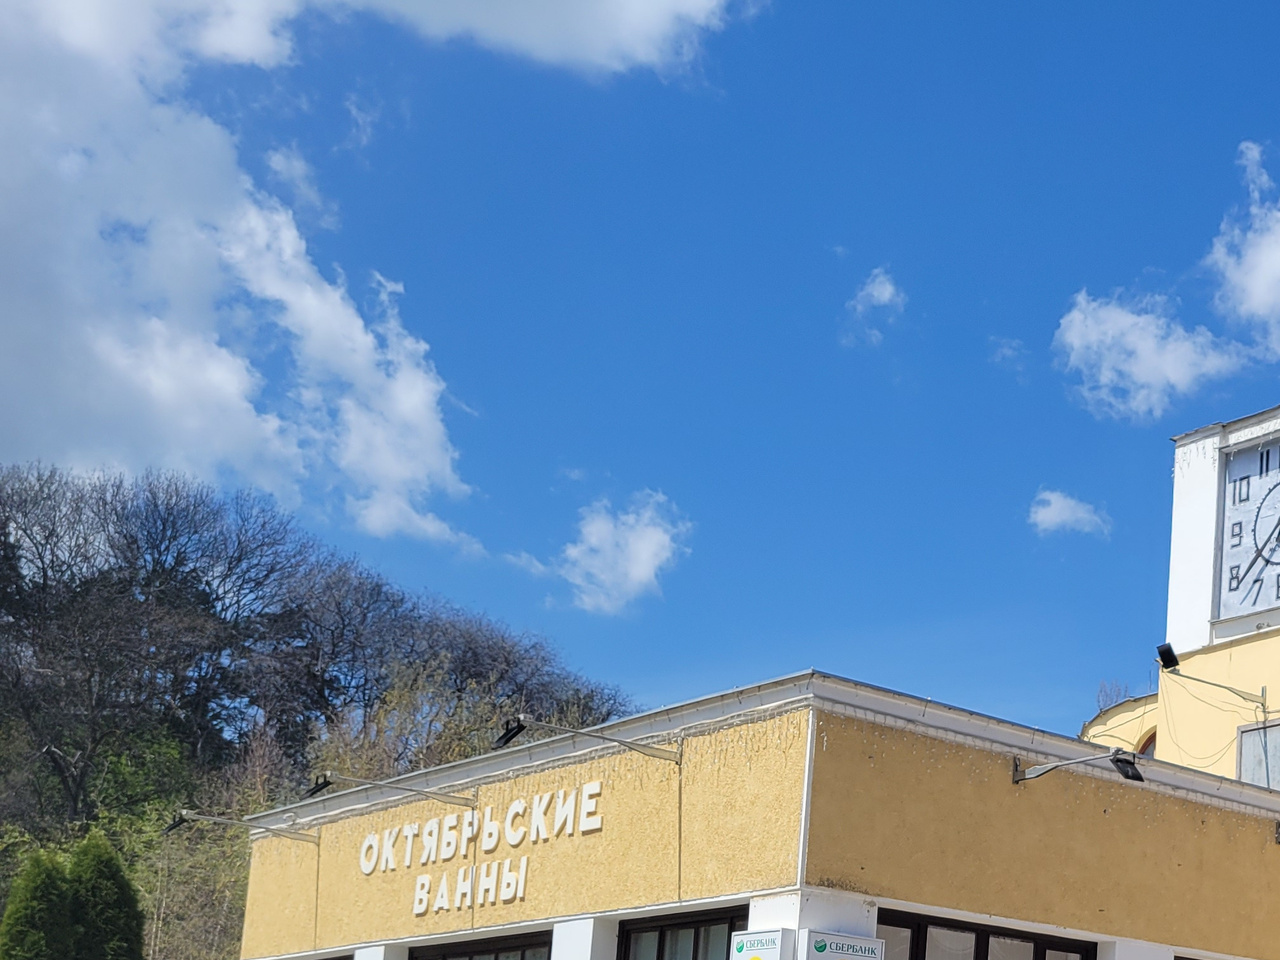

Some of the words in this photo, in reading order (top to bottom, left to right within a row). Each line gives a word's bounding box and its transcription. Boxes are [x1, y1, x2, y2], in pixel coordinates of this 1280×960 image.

[1259, 449, 1270, 479] 11
[1232, 477, 1250, 506] 10
[1231, 521, 1242, 549] 9
[1228, 565, 1241, 592] 8
[1251, 576, 1264, 606] 7
[359, 781, 603, 876] ОКТЯБРЬСКИЕ
[412, 855, 529, 916] ВАННЫ
[745, 937, 777, 949] СБЕРБАНК
[829, 941, 877, 956] СБЕРБАНК
